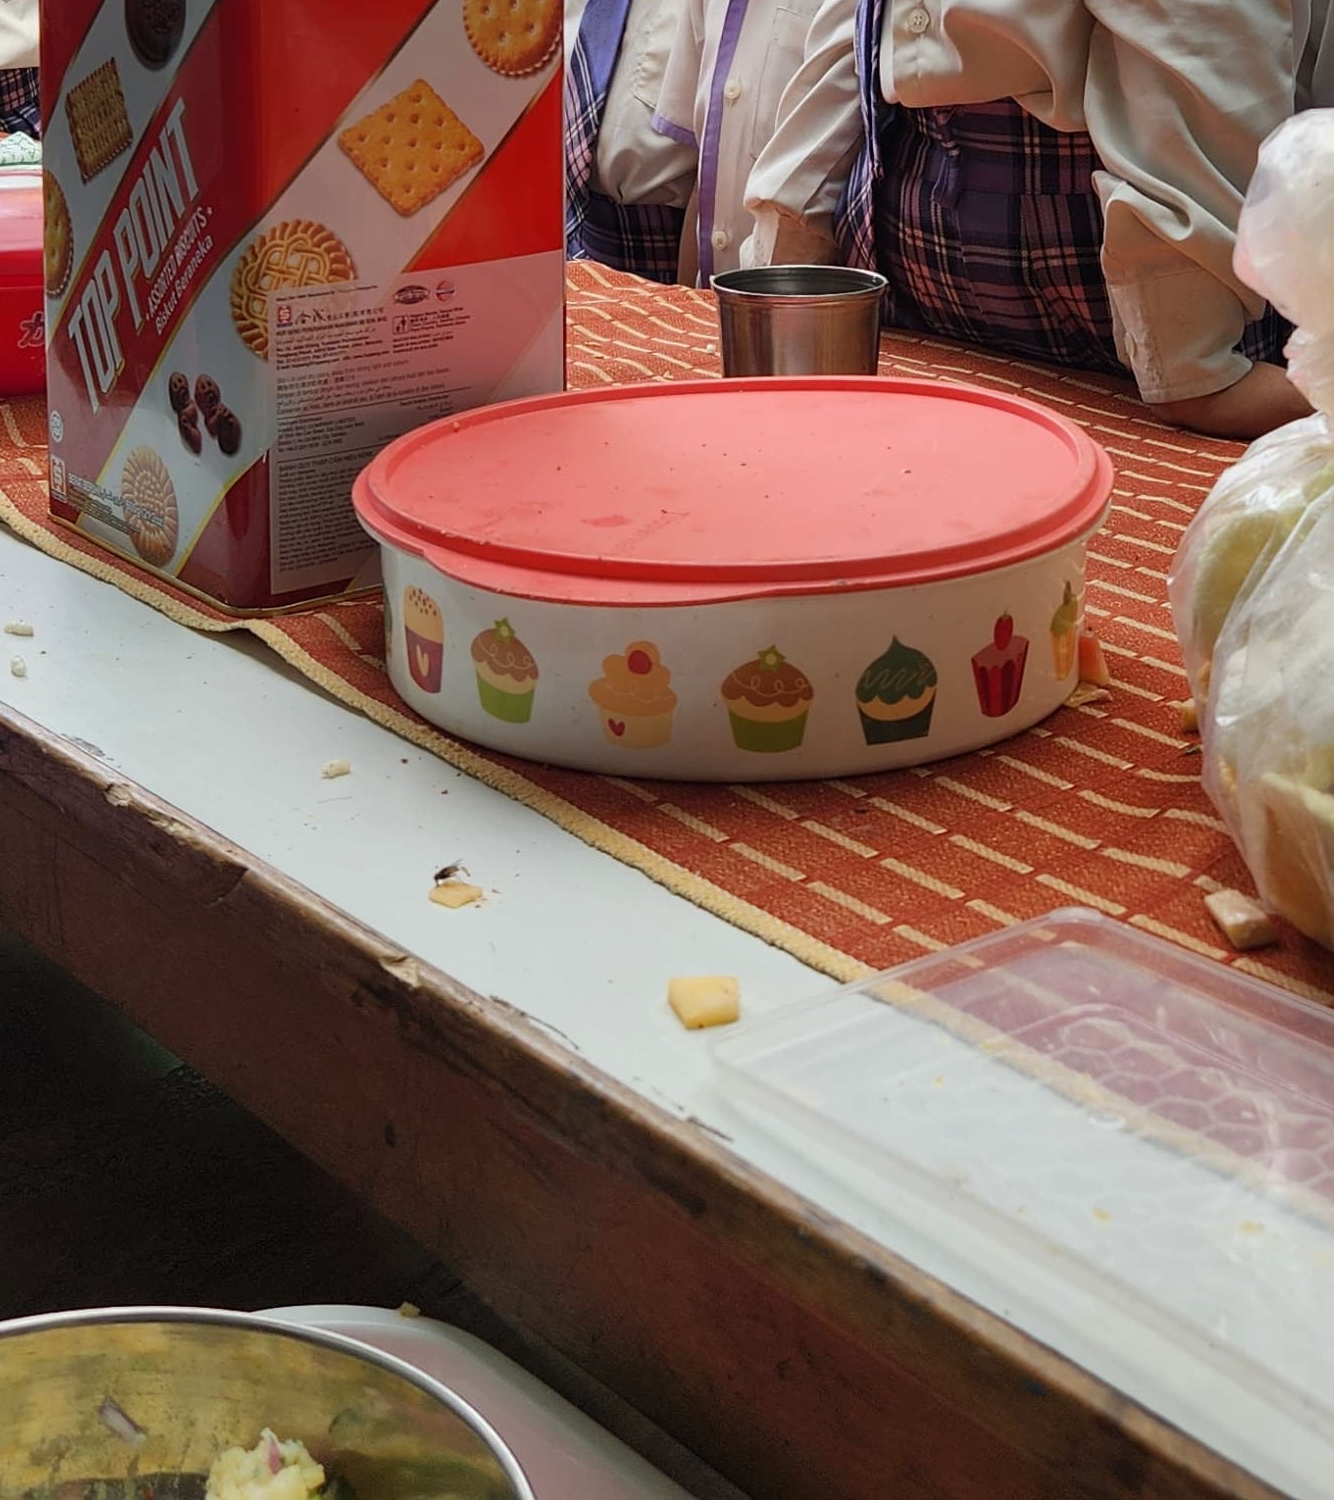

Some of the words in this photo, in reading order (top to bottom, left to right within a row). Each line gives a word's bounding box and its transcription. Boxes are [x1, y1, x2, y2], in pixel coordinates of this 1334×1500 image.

[68, 250, 125, 415] TOP
[114, 97, 200, 332] POINT
[174, 234, 214, 299] Beraneka
